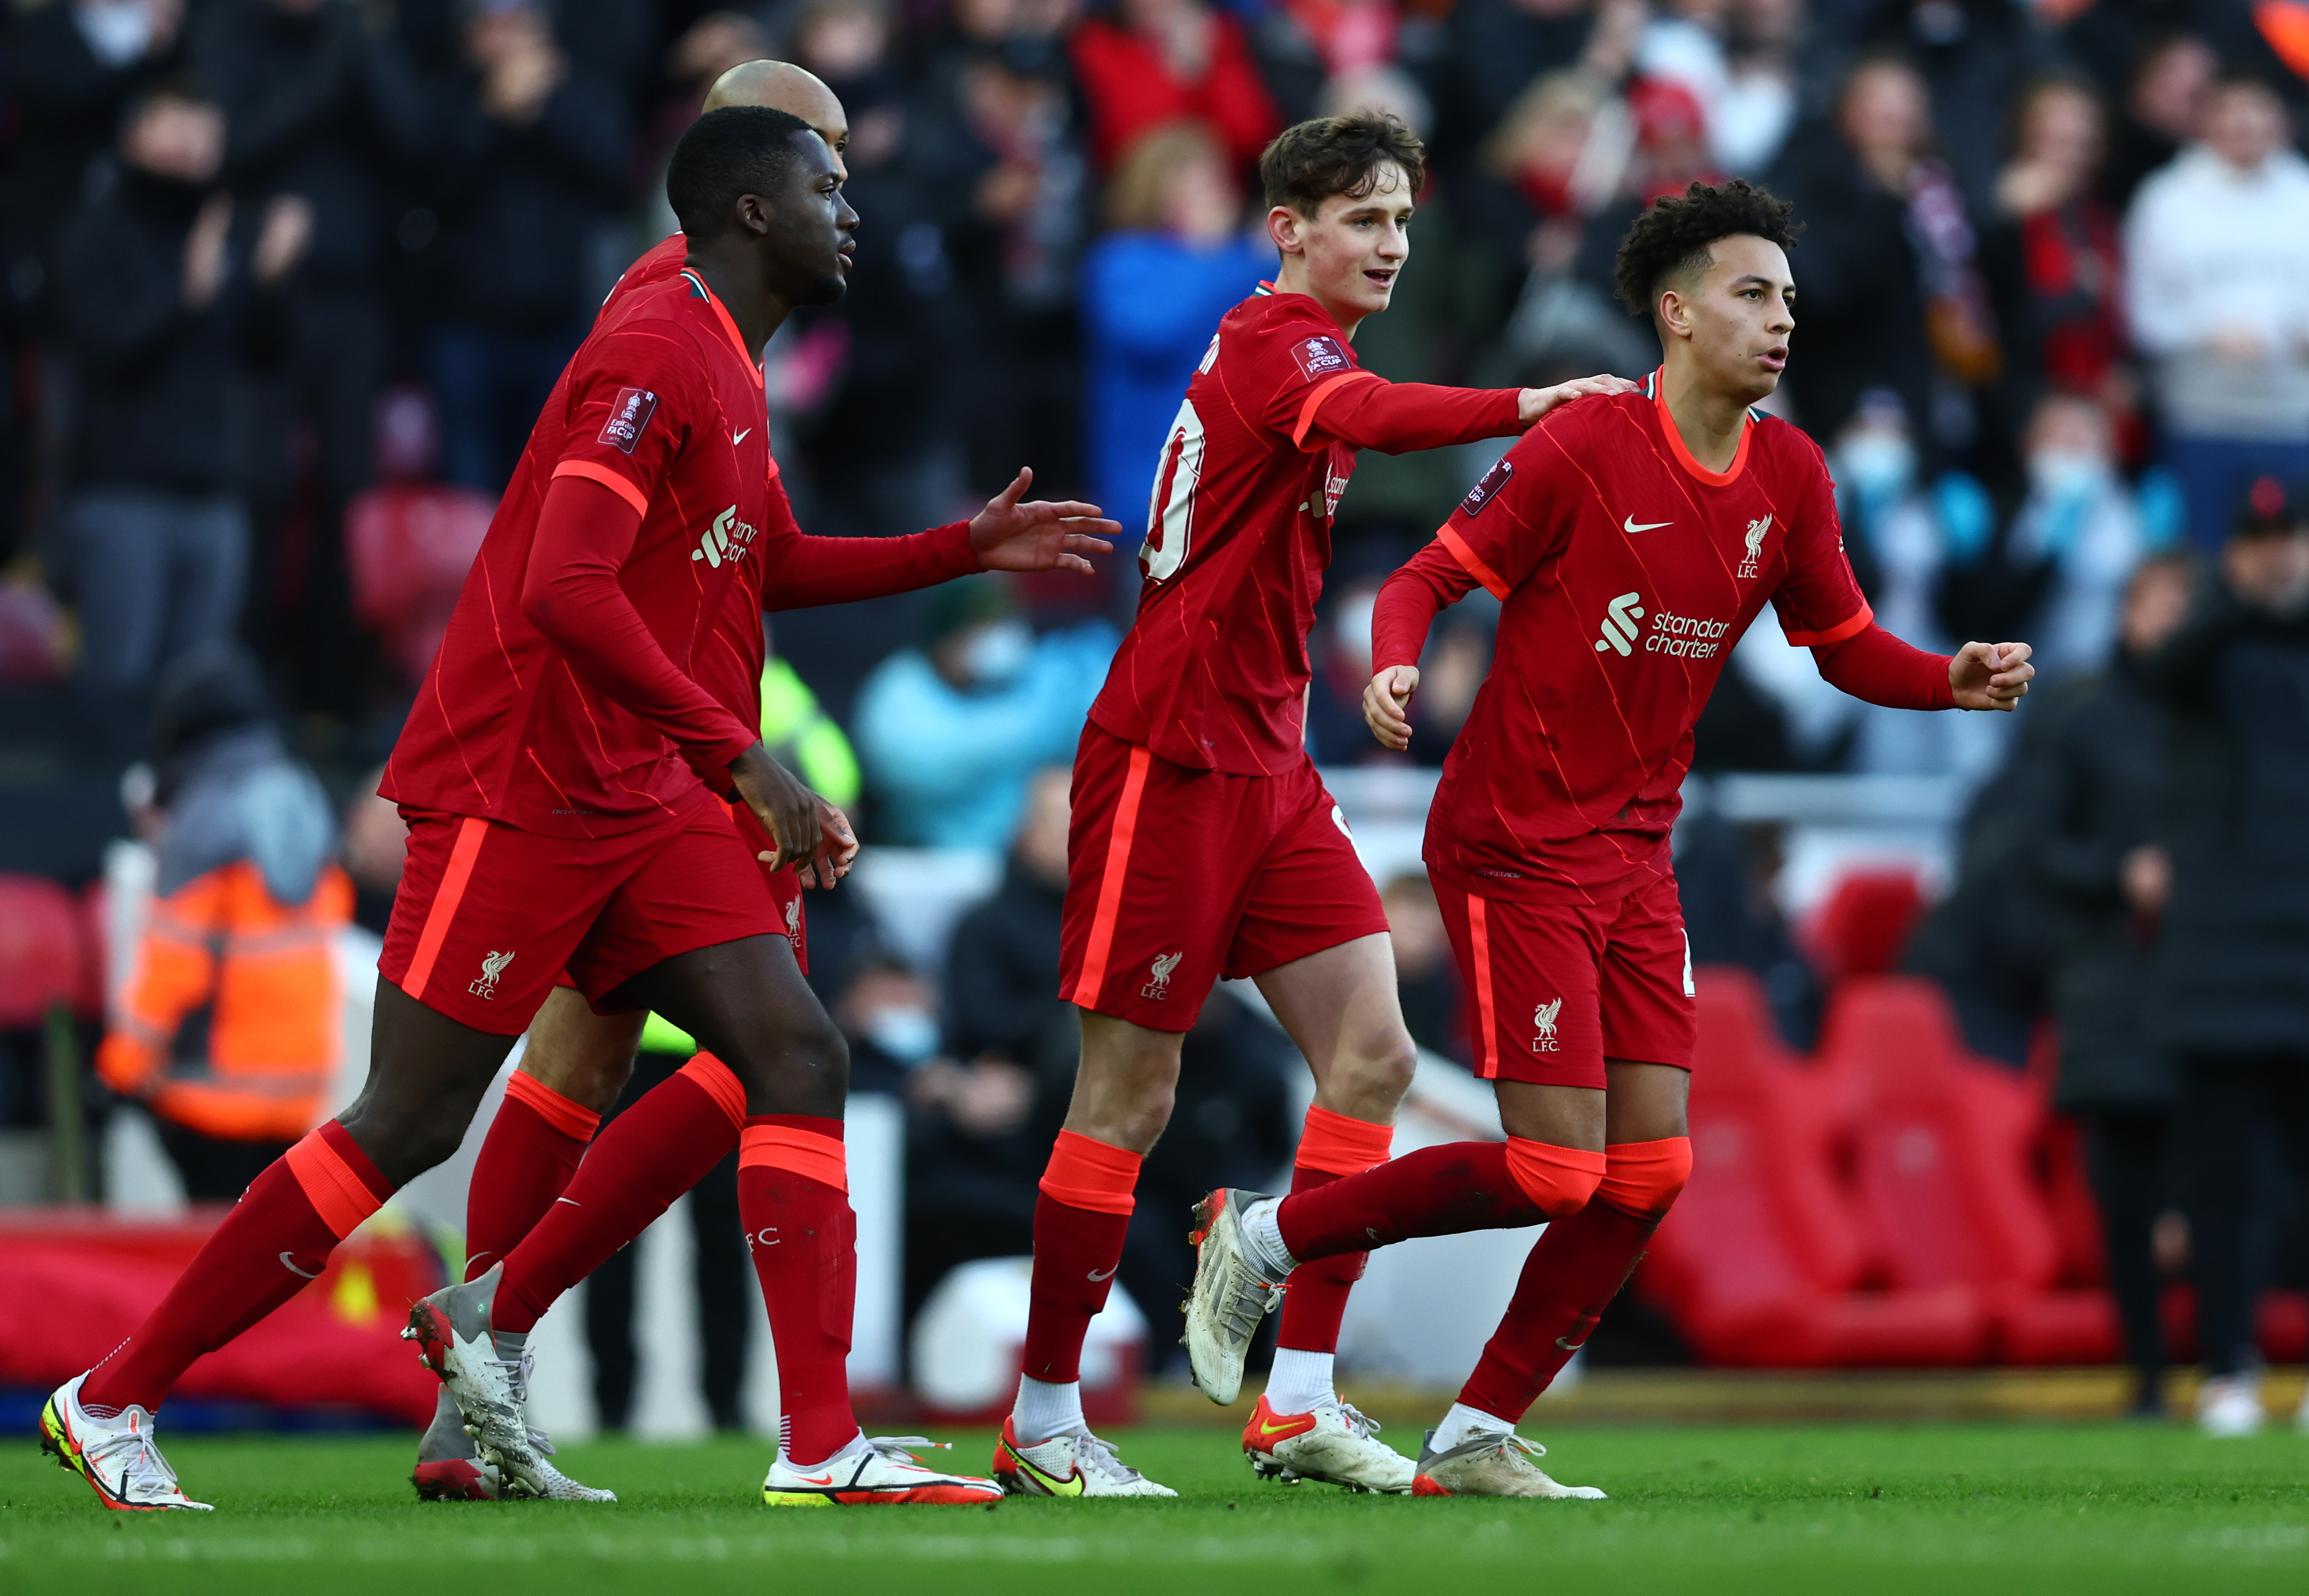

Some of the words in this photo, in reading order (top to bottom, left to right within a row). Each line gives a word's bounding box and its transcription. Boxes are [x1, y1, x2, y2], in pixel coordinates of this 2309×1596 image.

[1307, 355, 1340, 369] Emirates
[1309, 363, 1321, 373] FA
[607, 426, 617, 434] FA
[616, 426, 633, 440] CUP
[611, 418, 636, 434] Emirates
[1468, 489, 1481, 502] UP
[1737, 564, 1758, 578] L.F.C.
[1652, 611, 1730, 639] standar
[1646, 632, 1719, 659] charter
[468, 982, 495, 1001] L.F.C.
[1532, 1040, 1561, 1052] L.F.C.
